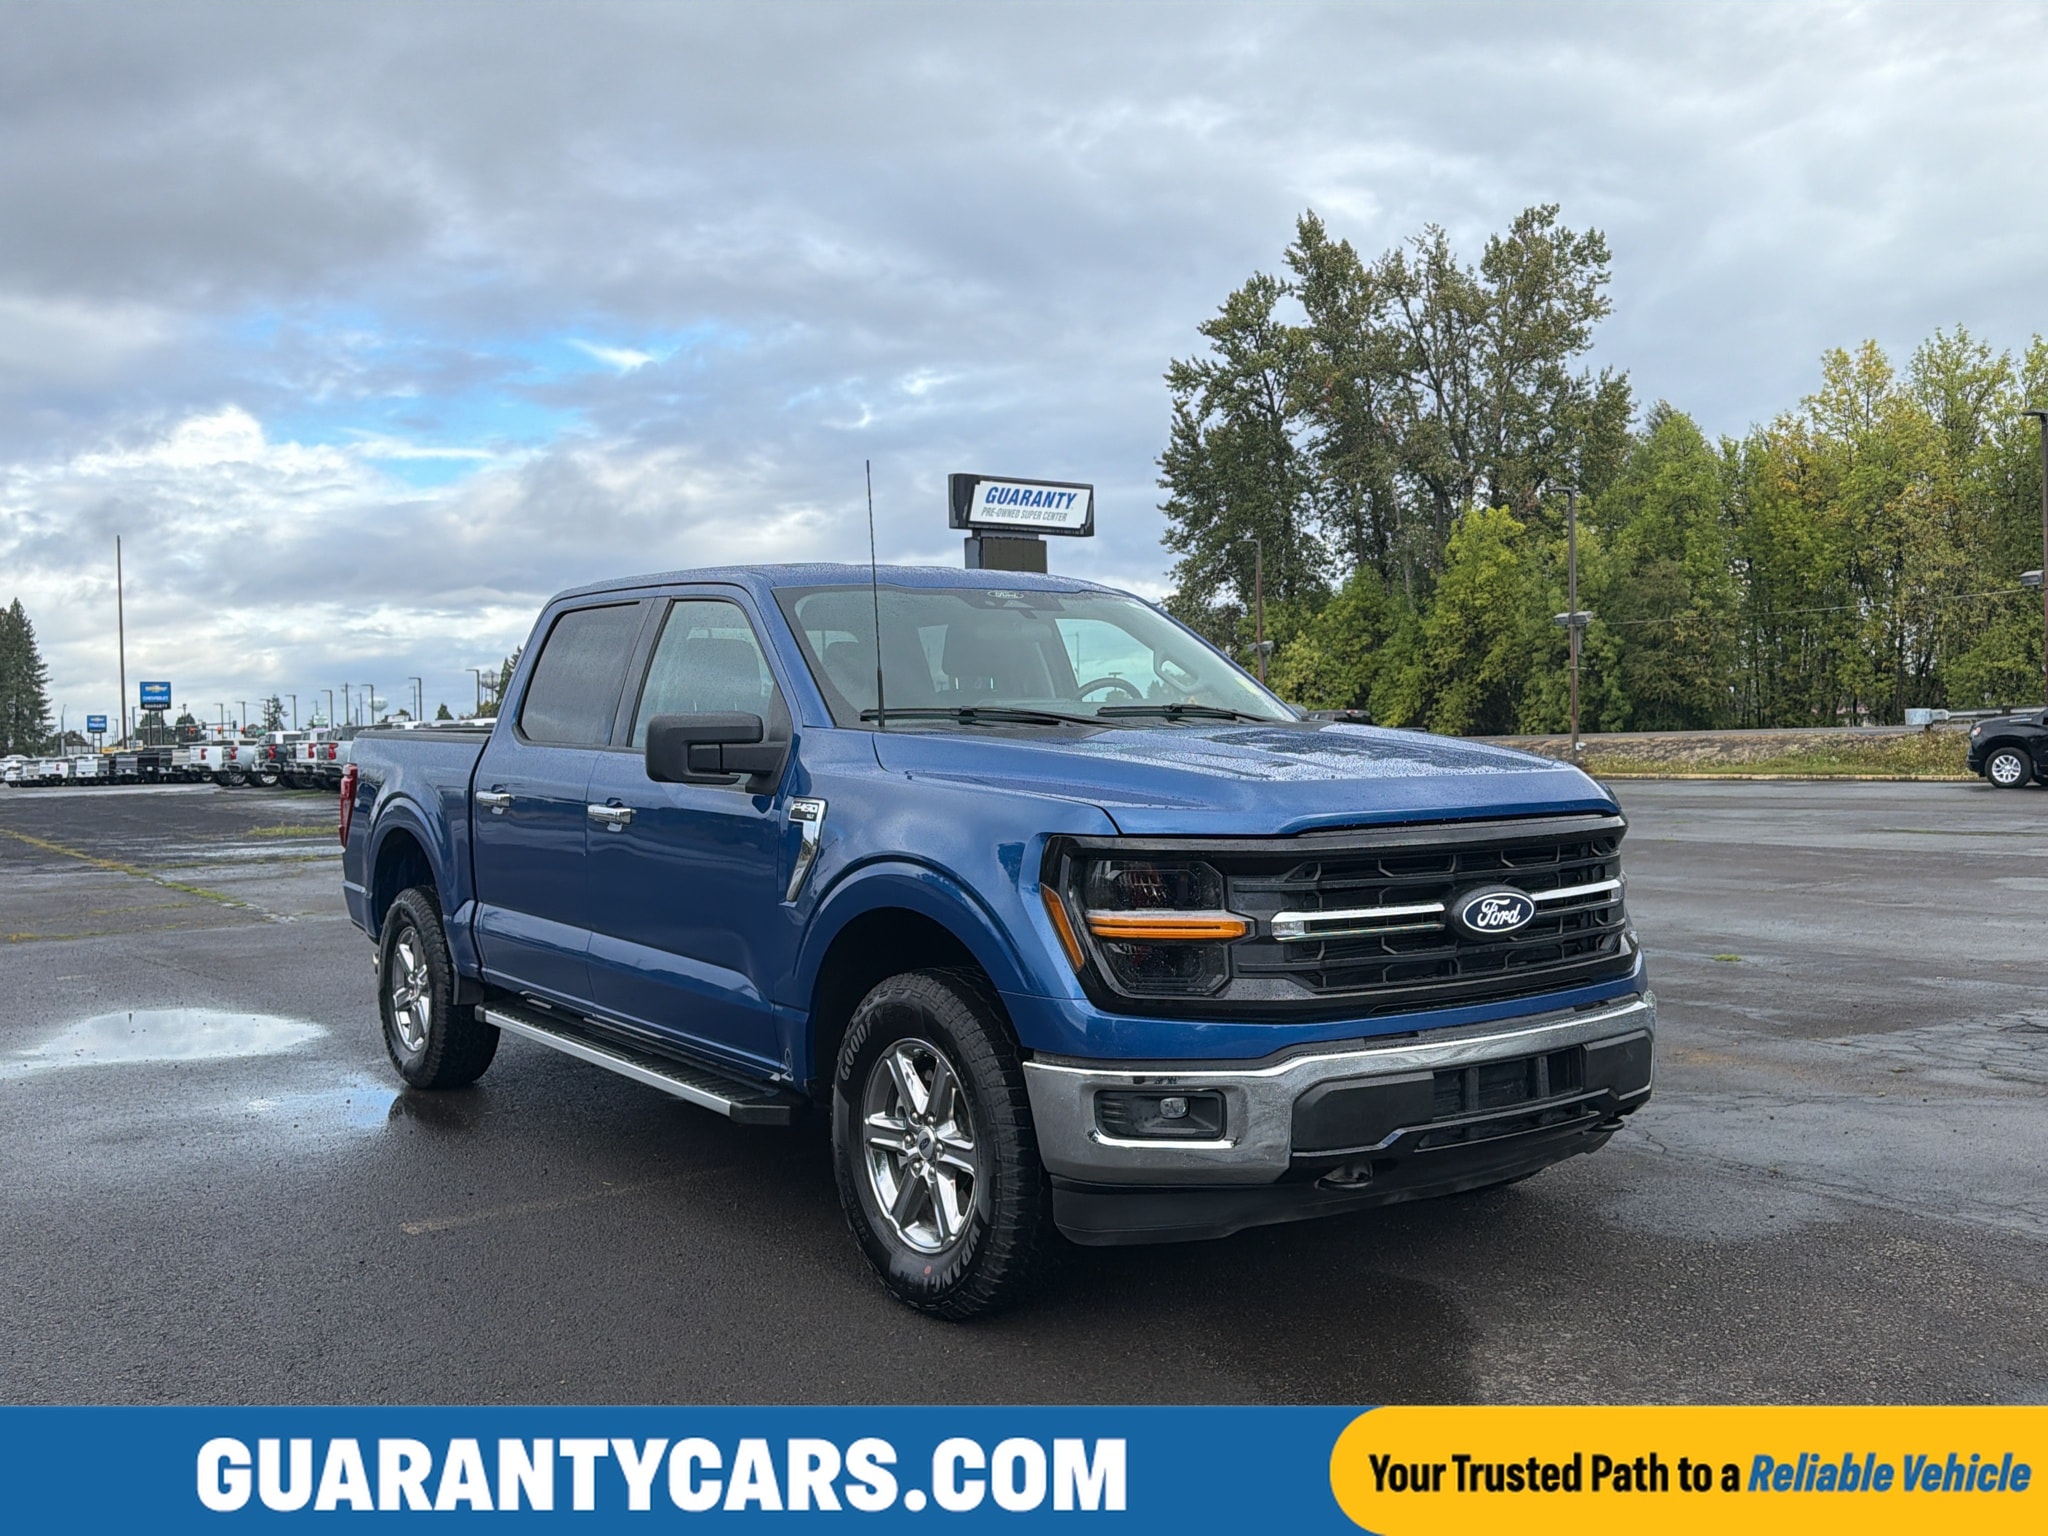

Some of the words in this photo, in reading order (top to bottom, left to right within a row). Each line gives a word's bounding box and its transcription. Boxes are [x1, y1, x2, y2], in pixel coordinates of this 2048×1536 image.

[985, 486, 1077, 509] GUARANTY
[981, 506, 1020, 519] PRE-OWNED
[1020, 510, 1041, 520] SUPER
[1042, 512, 1067, 522] CENTER
[1477, 898, 1521, 927] Ford
